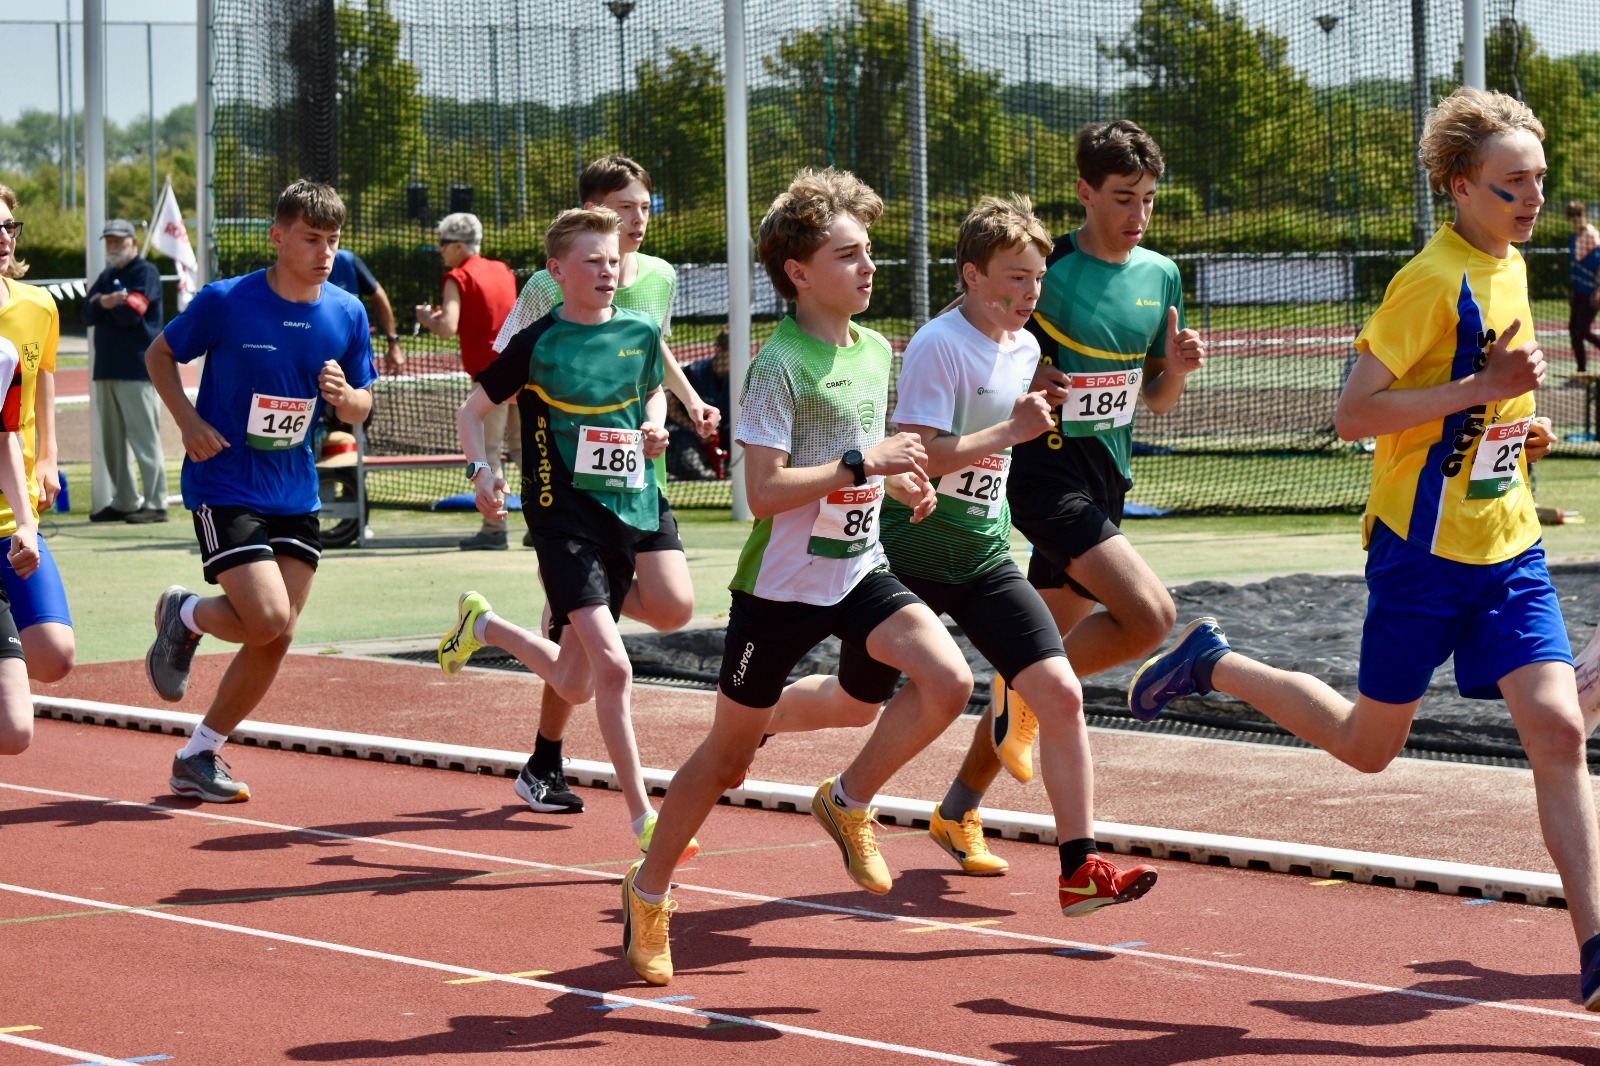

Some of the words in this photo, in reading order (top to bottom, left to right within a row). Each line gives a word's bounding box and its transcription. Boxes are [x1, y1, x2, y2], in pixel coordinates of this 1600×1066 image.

[283, 321, 305, 329] CRAFT
[825, 379, 848, 389] CRAFT
[1085, 375, 1126, 387] SPAR
[269, 400, 306, 411] SPAR
[1079, 390, 1127, 417] 184
[1441, 328, 1496, 477] achies
[262, 413, 306, 434] 146
[599, 432, 634, 443] SPAR
[534, 415, 553, 507] SCORPIO
[591, 447, 637, 473] 186
[843, 486, 881, 503] SPAR
[956, 470, 1002, 501] 128
[843, 506, 875, 537] 86
[736, 641, 755, 679] CRAFT
